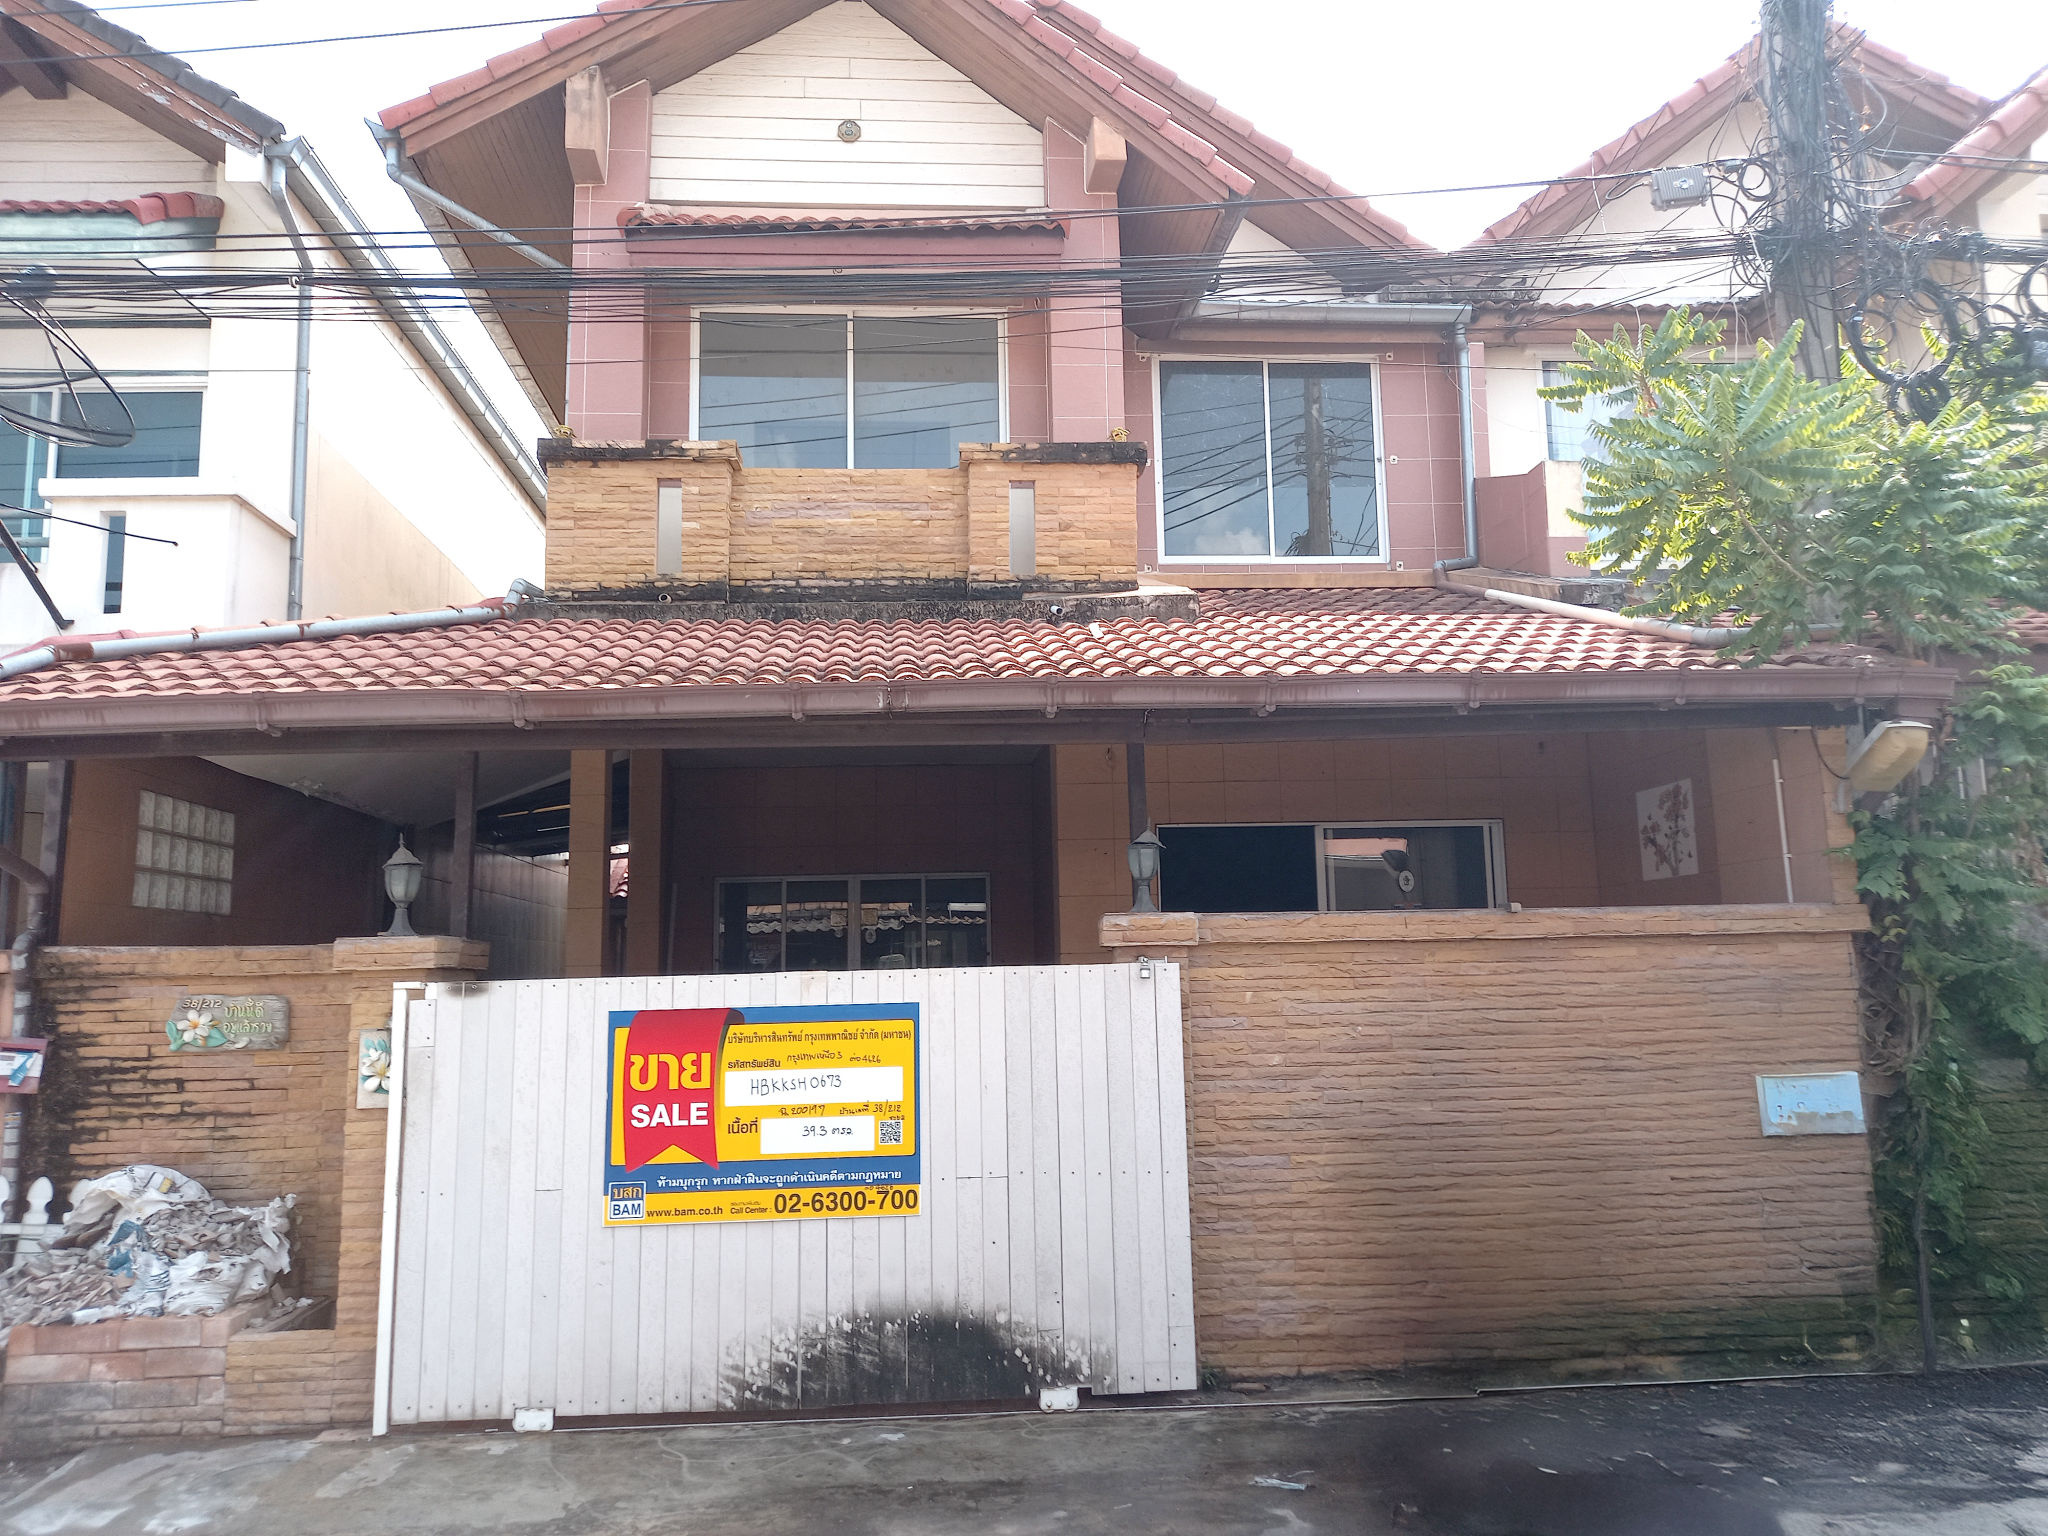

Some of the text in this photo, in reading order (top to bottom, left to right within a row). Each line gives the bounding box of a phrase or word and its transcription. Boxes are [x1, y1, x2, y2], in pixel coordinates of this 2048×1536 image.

[727, 1029, 911, 1046] บริษัทบริหารสินทรัพย์ กรุงเทพพาณิชย์ จำกัด (มหาชน)
[727, 1058, 781, 1069] รหัสทรัพย์สิน
[629, 1052, 711, 1092] ขาย
[630, 1102, 709, 1128] SALE
[873, 1099, 902, 1116] 38/212
[727, 1116, 758, 1134] เนื้อที่
[802, 1125, 828, 1137] 39.3
[657, 1175, 708, 1191] ห้ามบุกรุก
[613, 1186, 642, 1199] บสก
[774, 1189, 918, 1213] 02-6300-700
[612, 1203, 641, 1216] BAM
[646, 1205, 723, 1218] www.bam.co.th
[730, 1207, 743, 1215] Call
[745, 1206, 768, 1214] Center
